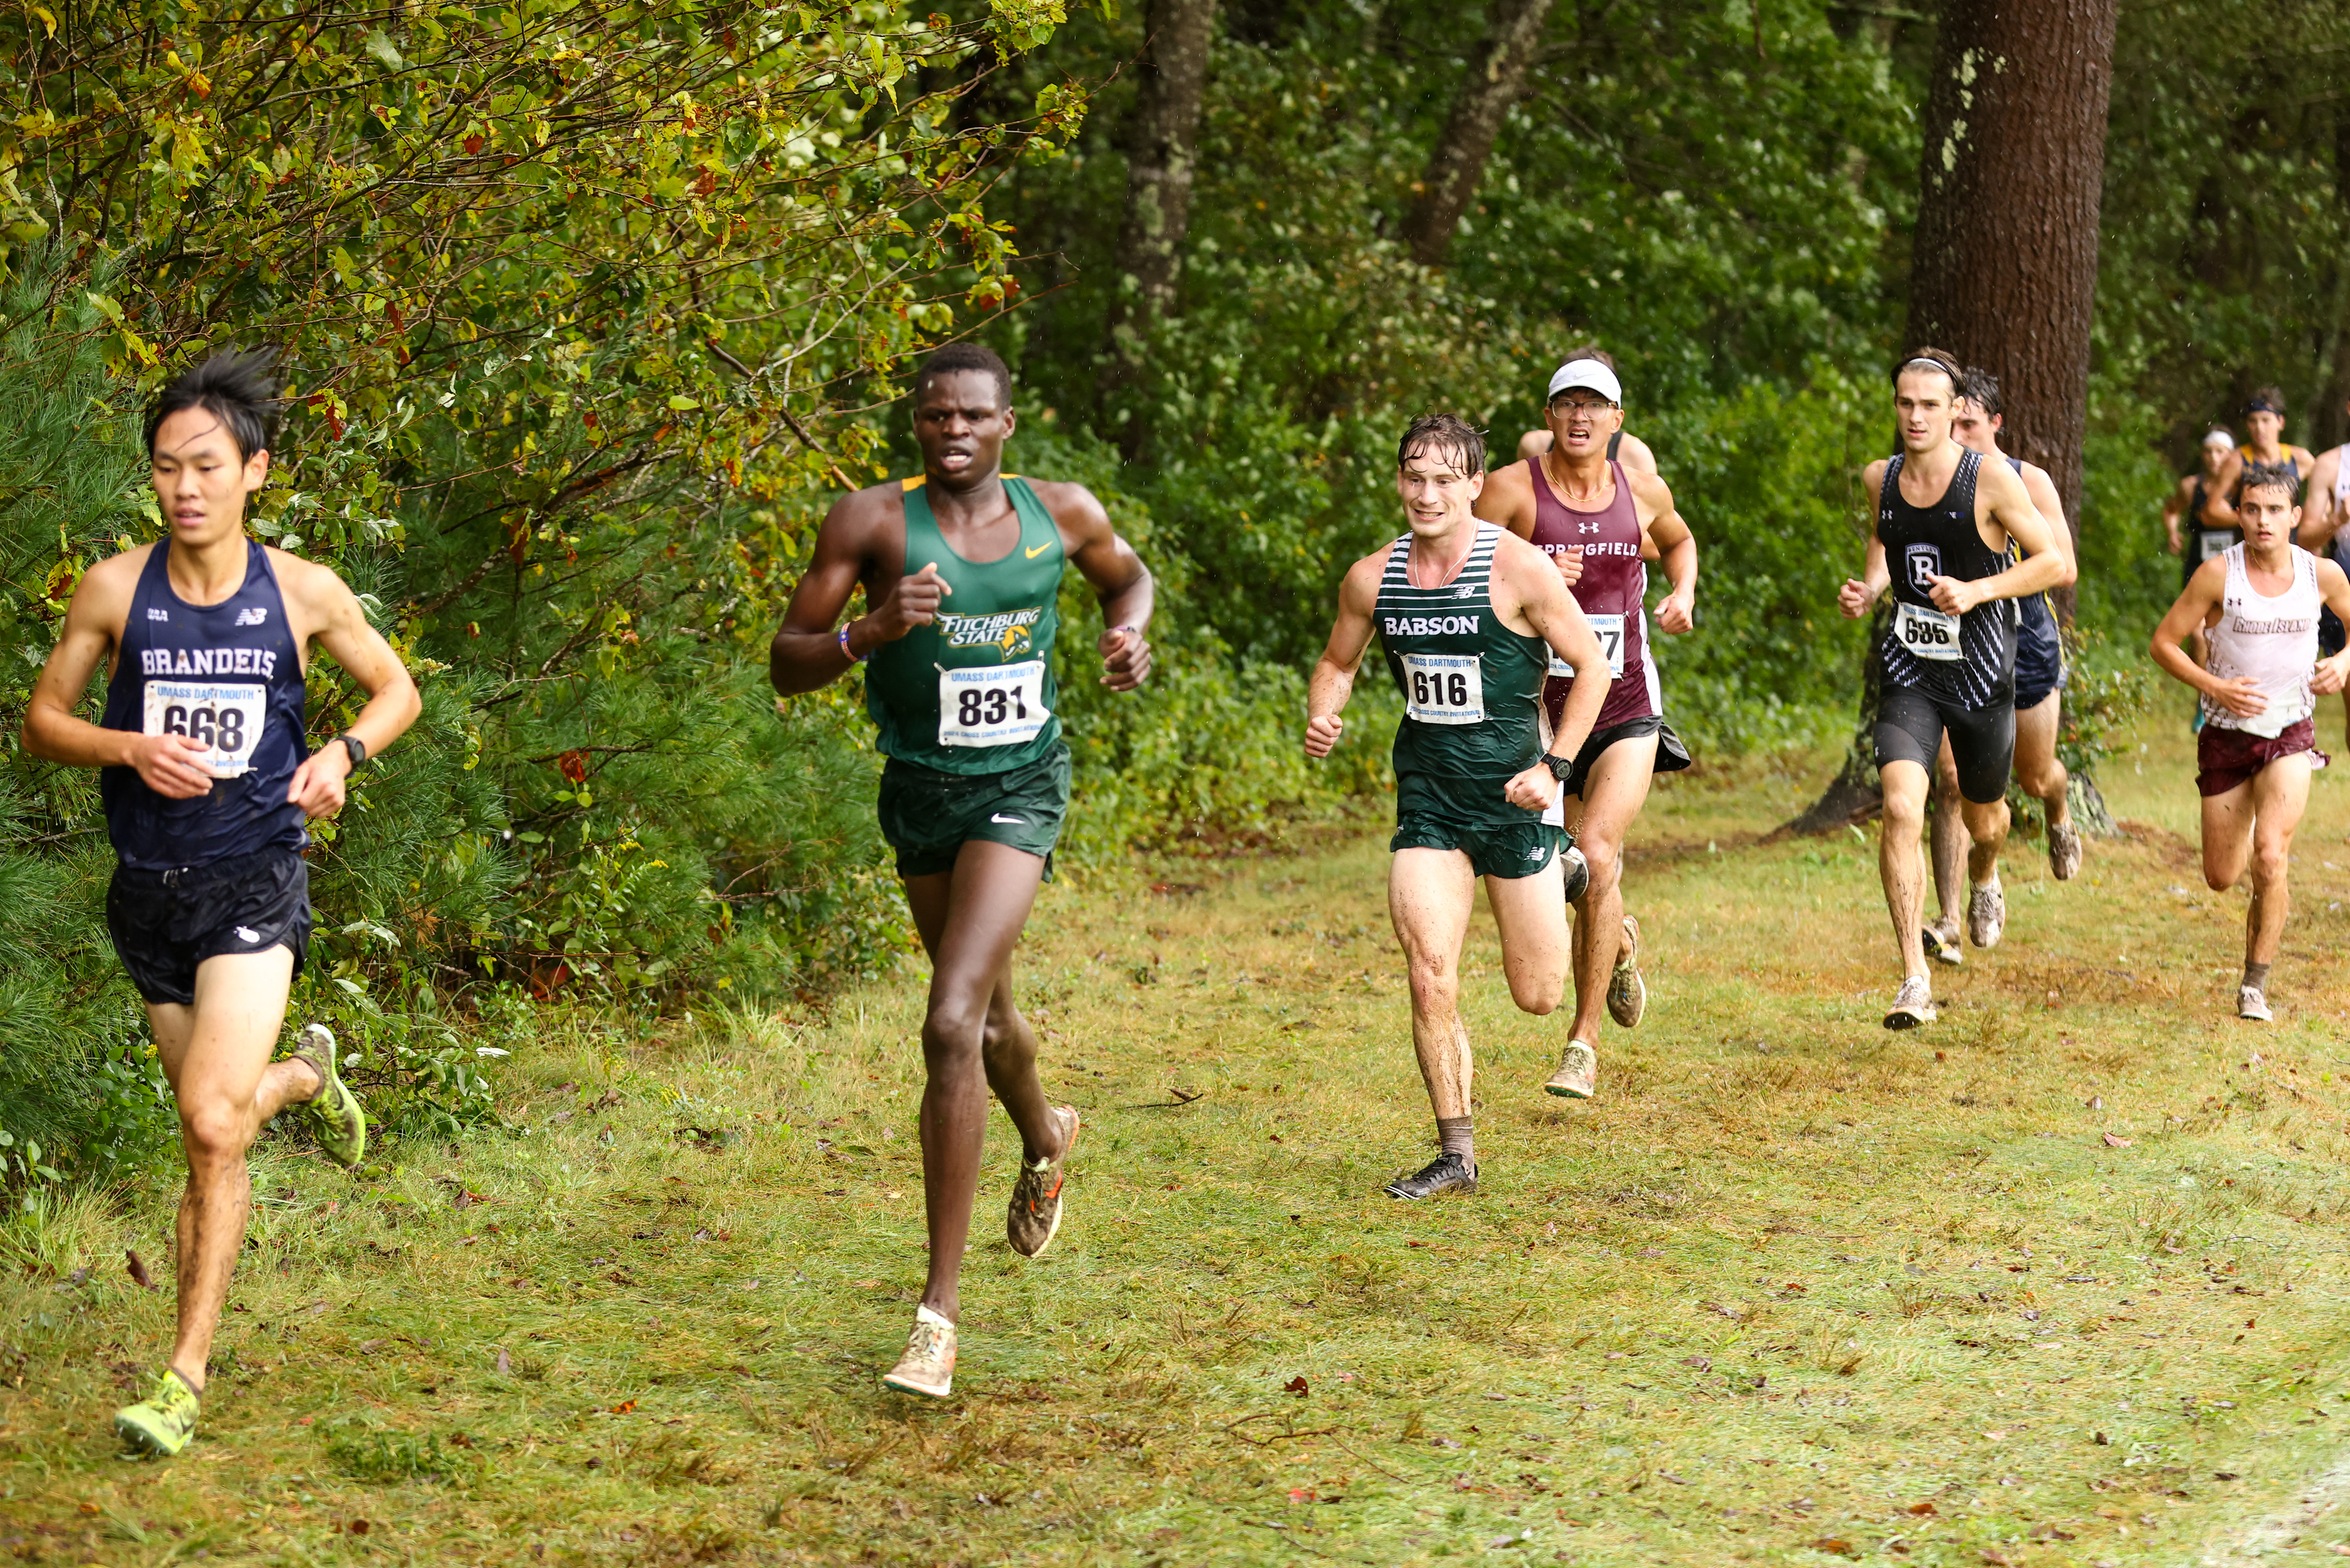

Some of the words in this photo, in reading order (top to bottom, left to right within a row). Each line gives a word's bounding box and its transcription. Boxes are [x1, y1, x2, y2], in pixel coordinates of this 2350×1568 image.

[935, 608, 1041, 633] FITCHBURG
[1384, 616, 1480, 636] BABSON
[1905, 617, 1950, 645] 635
[2232, 616, 2270, 634] RHODE
[2270, 617, 2311, 633] ISLAND
[949, 627, 1009, 646] STATE
[141, 648, 278, 677] BRANDEIS
[1408, 656, 1427, 667] UMASS
[1429, 658, 1471, 667] DARTMOUTH
[951, 672, 985, 682] UMASS
[986, 667, 1036, 681] DARTMOUTH
[157, 685, 191, 698] UMASS
[194, 687, 255, 700] DARTMOUTH
[1413, 671, 1468, 706] 616
[958, 685, 1027, 727] 831
[164, 705, 245, 753] 668
